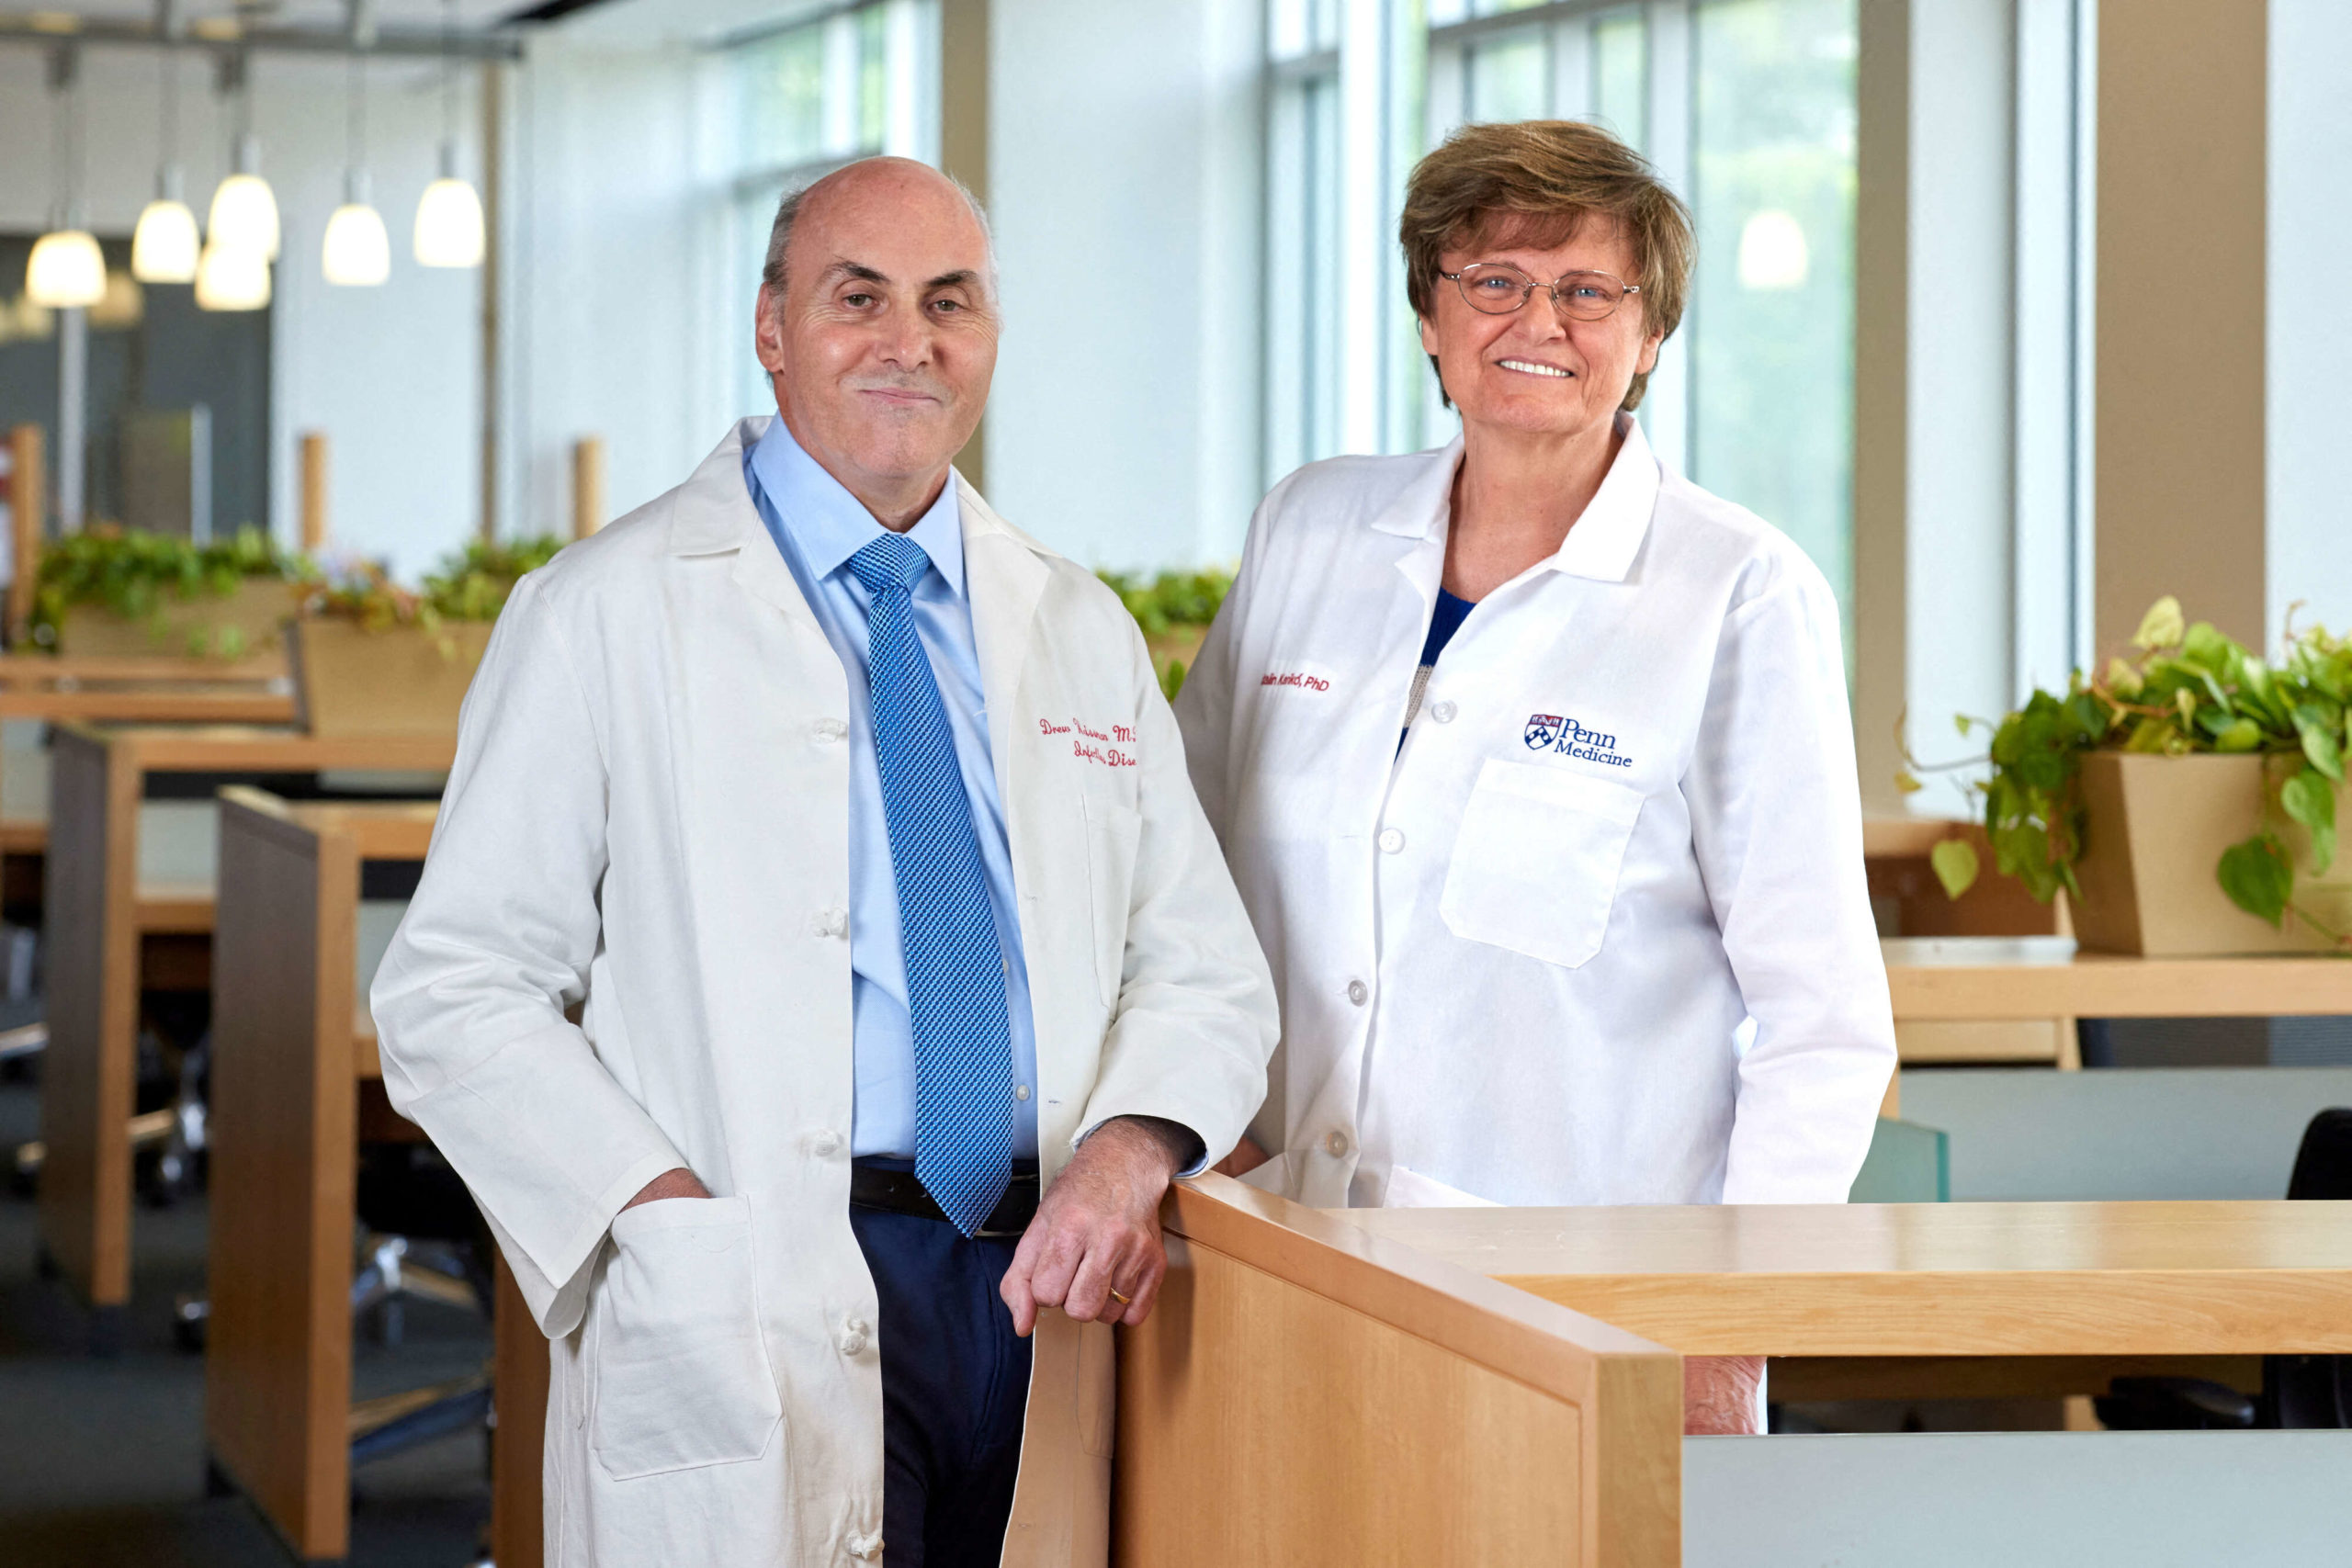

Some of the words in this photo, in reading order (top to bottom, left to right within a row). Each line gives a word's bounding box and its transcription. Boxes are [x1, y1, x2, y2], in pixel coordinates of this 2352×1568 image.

[1304, 675, 1329, 692] PhD
[1039, 718, 1071, 735] Drew
[1559, 718, 1616, 750] Penn
[1554, 739, 1633, 767] Medicine
